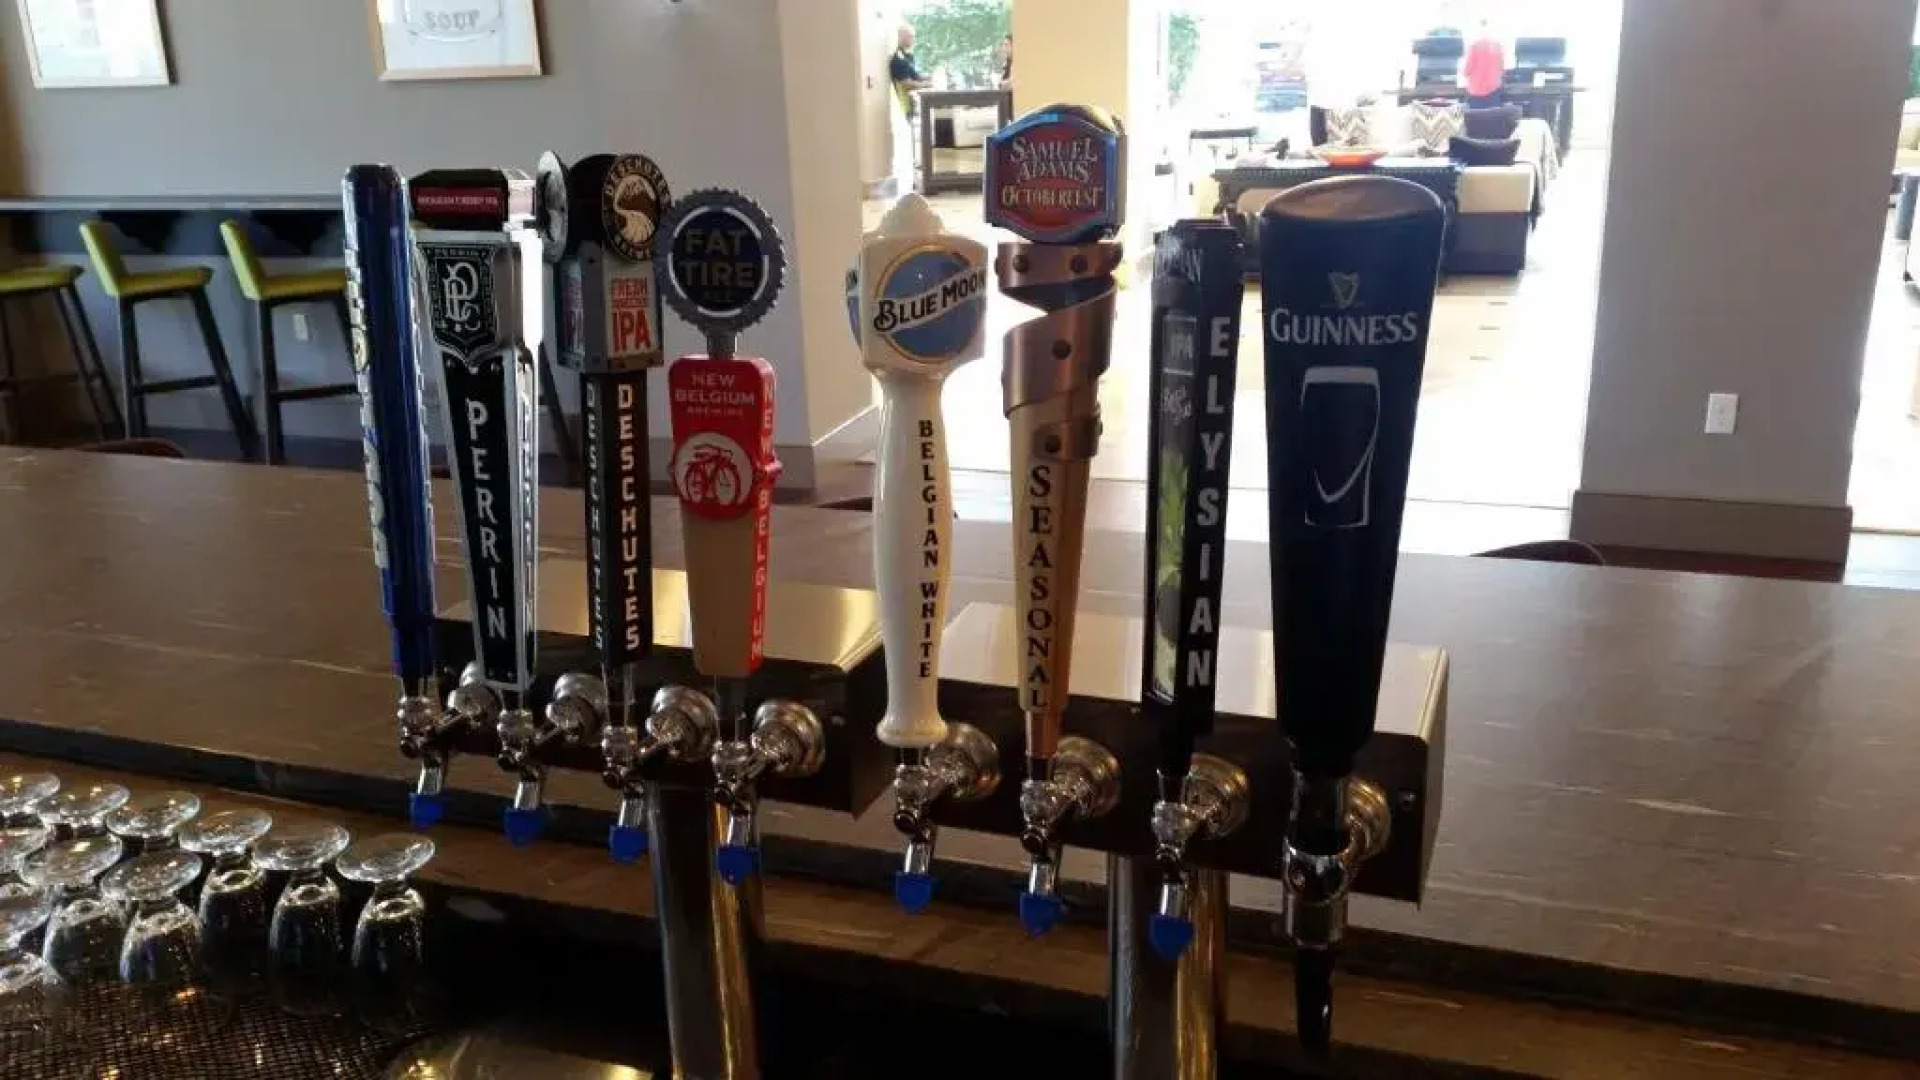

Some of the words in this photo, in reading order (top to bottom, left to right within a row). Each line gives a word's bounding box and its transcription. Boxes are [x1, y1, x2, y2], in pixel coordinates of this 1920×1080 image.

[424, 9, 481, 30] SOUP
[1010, 136, 1098, 163] SAMUEL
[1018, 160, 1090, 183] ADAMS
[1002, 184, 1104, 211] OCTOBERFEST
[684, 228, 747, 256] FAT
[679, 262, 755, 287] TIRE
[873, 292, 938, 332] BLUE
[941, 268, 987, 308] MOON
[611, 308, 653, 352] IPA
[1270, 307, 1419, 346] GUINNESS
[675, 388, 755, 406] BELGIUM
[691, 374, 736, 387] NEW
[918, 419, 939, 567] BELGIAN
[1187, 316, 1231, 687] ELYSIAN
[466, 398, 507, 640] PERRIN
[586, 382, 603, 650] DESCHUTES
[617, 383, 641, 651] DESCHUTES
[751, 490, 768, 661] BELGIUM
[1027, 465, 1052, 708] SEASONAL
[919, 582, 939, 678] WHITE
